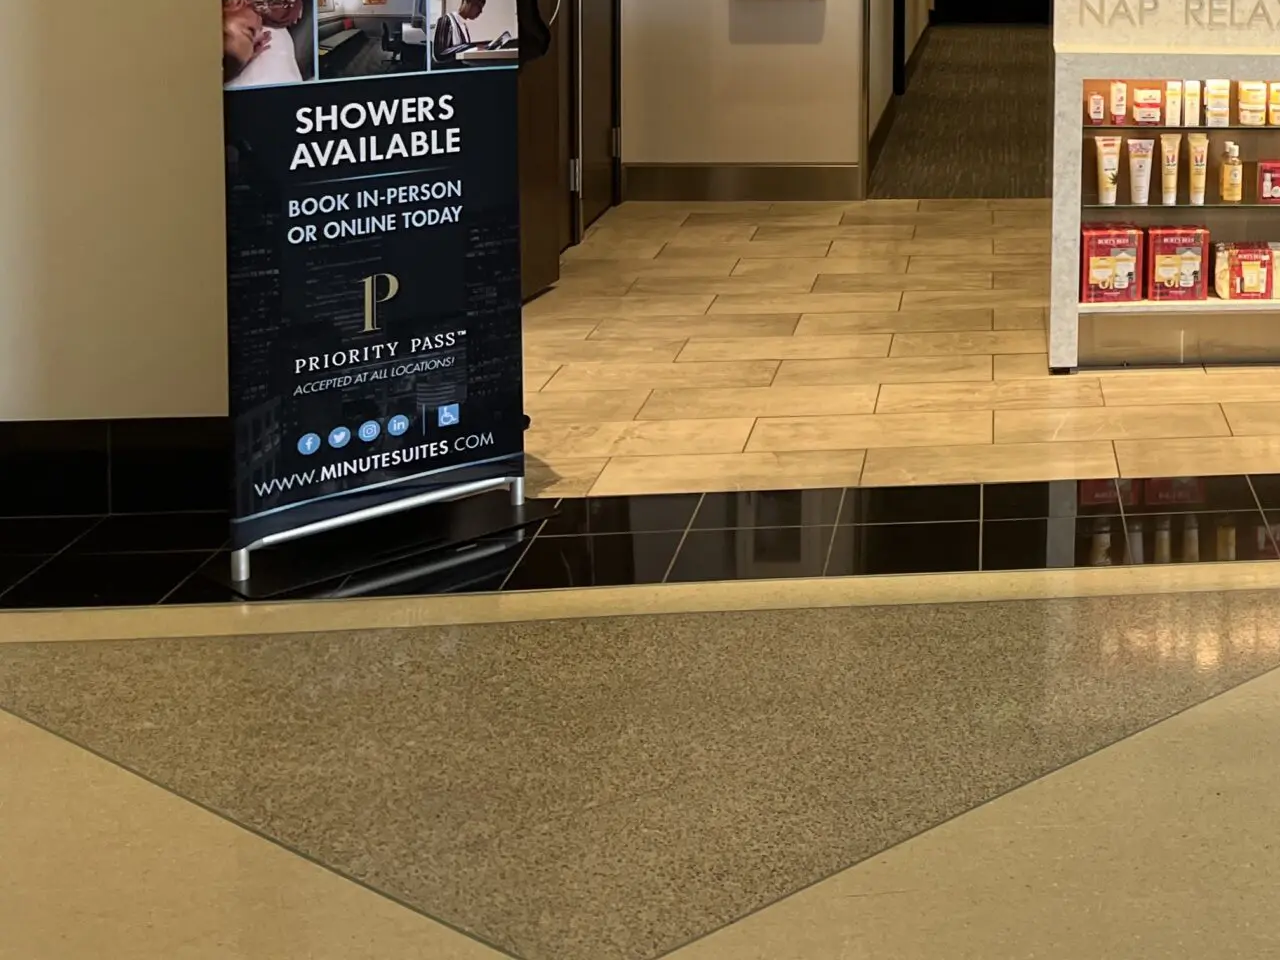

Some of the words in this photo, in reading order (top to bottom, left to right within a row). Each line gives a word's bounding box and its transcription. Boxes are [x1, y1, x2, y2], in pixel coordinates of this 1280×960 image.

[295, 94, 455, 134] SHOWERS
[289, 127, 461, 171] AVAILABLE
[288, 193, 350, 218] BOOK
[356, 179, 462, 208] IN-PERSON
[287, 224, 318, 244] OR
[323, 213, 397, 239] ONLINE
[401, 205, 463, 229] TODAY
[293, 375, 353, 397] ACCEPTED
[353, 373, 369, 385] AT
[370, 369, 389, 381] ALL
[390, 356, 455, 377] LOCATIONS!
[294, 341, 400, 374] PRIORITY
